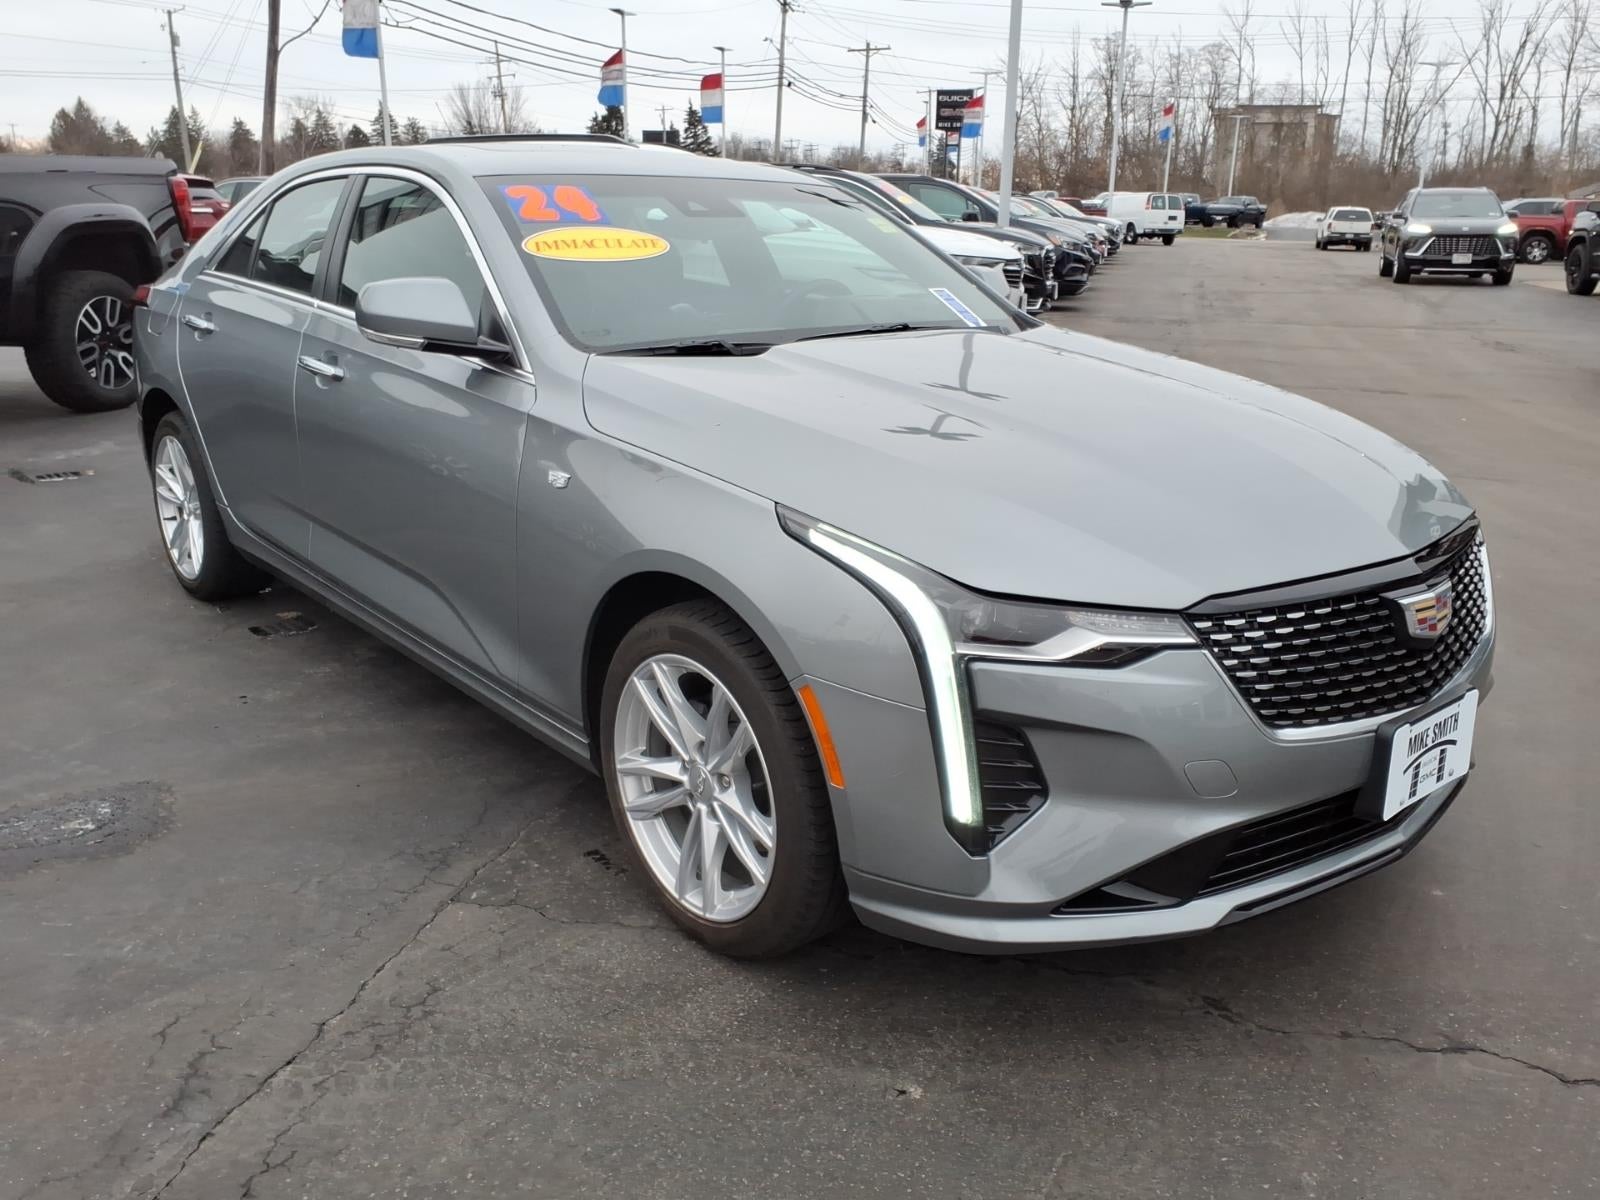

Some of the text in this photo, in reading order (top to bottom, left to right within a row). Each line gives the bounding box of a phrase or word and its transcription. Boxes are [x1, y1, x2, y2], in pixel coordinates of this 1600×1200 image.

[505, 185, 602, 222] 24
[534, 237, 661, 252] IMMACULATE
[1407, 711, 1459, 758] MIKE SMITH
